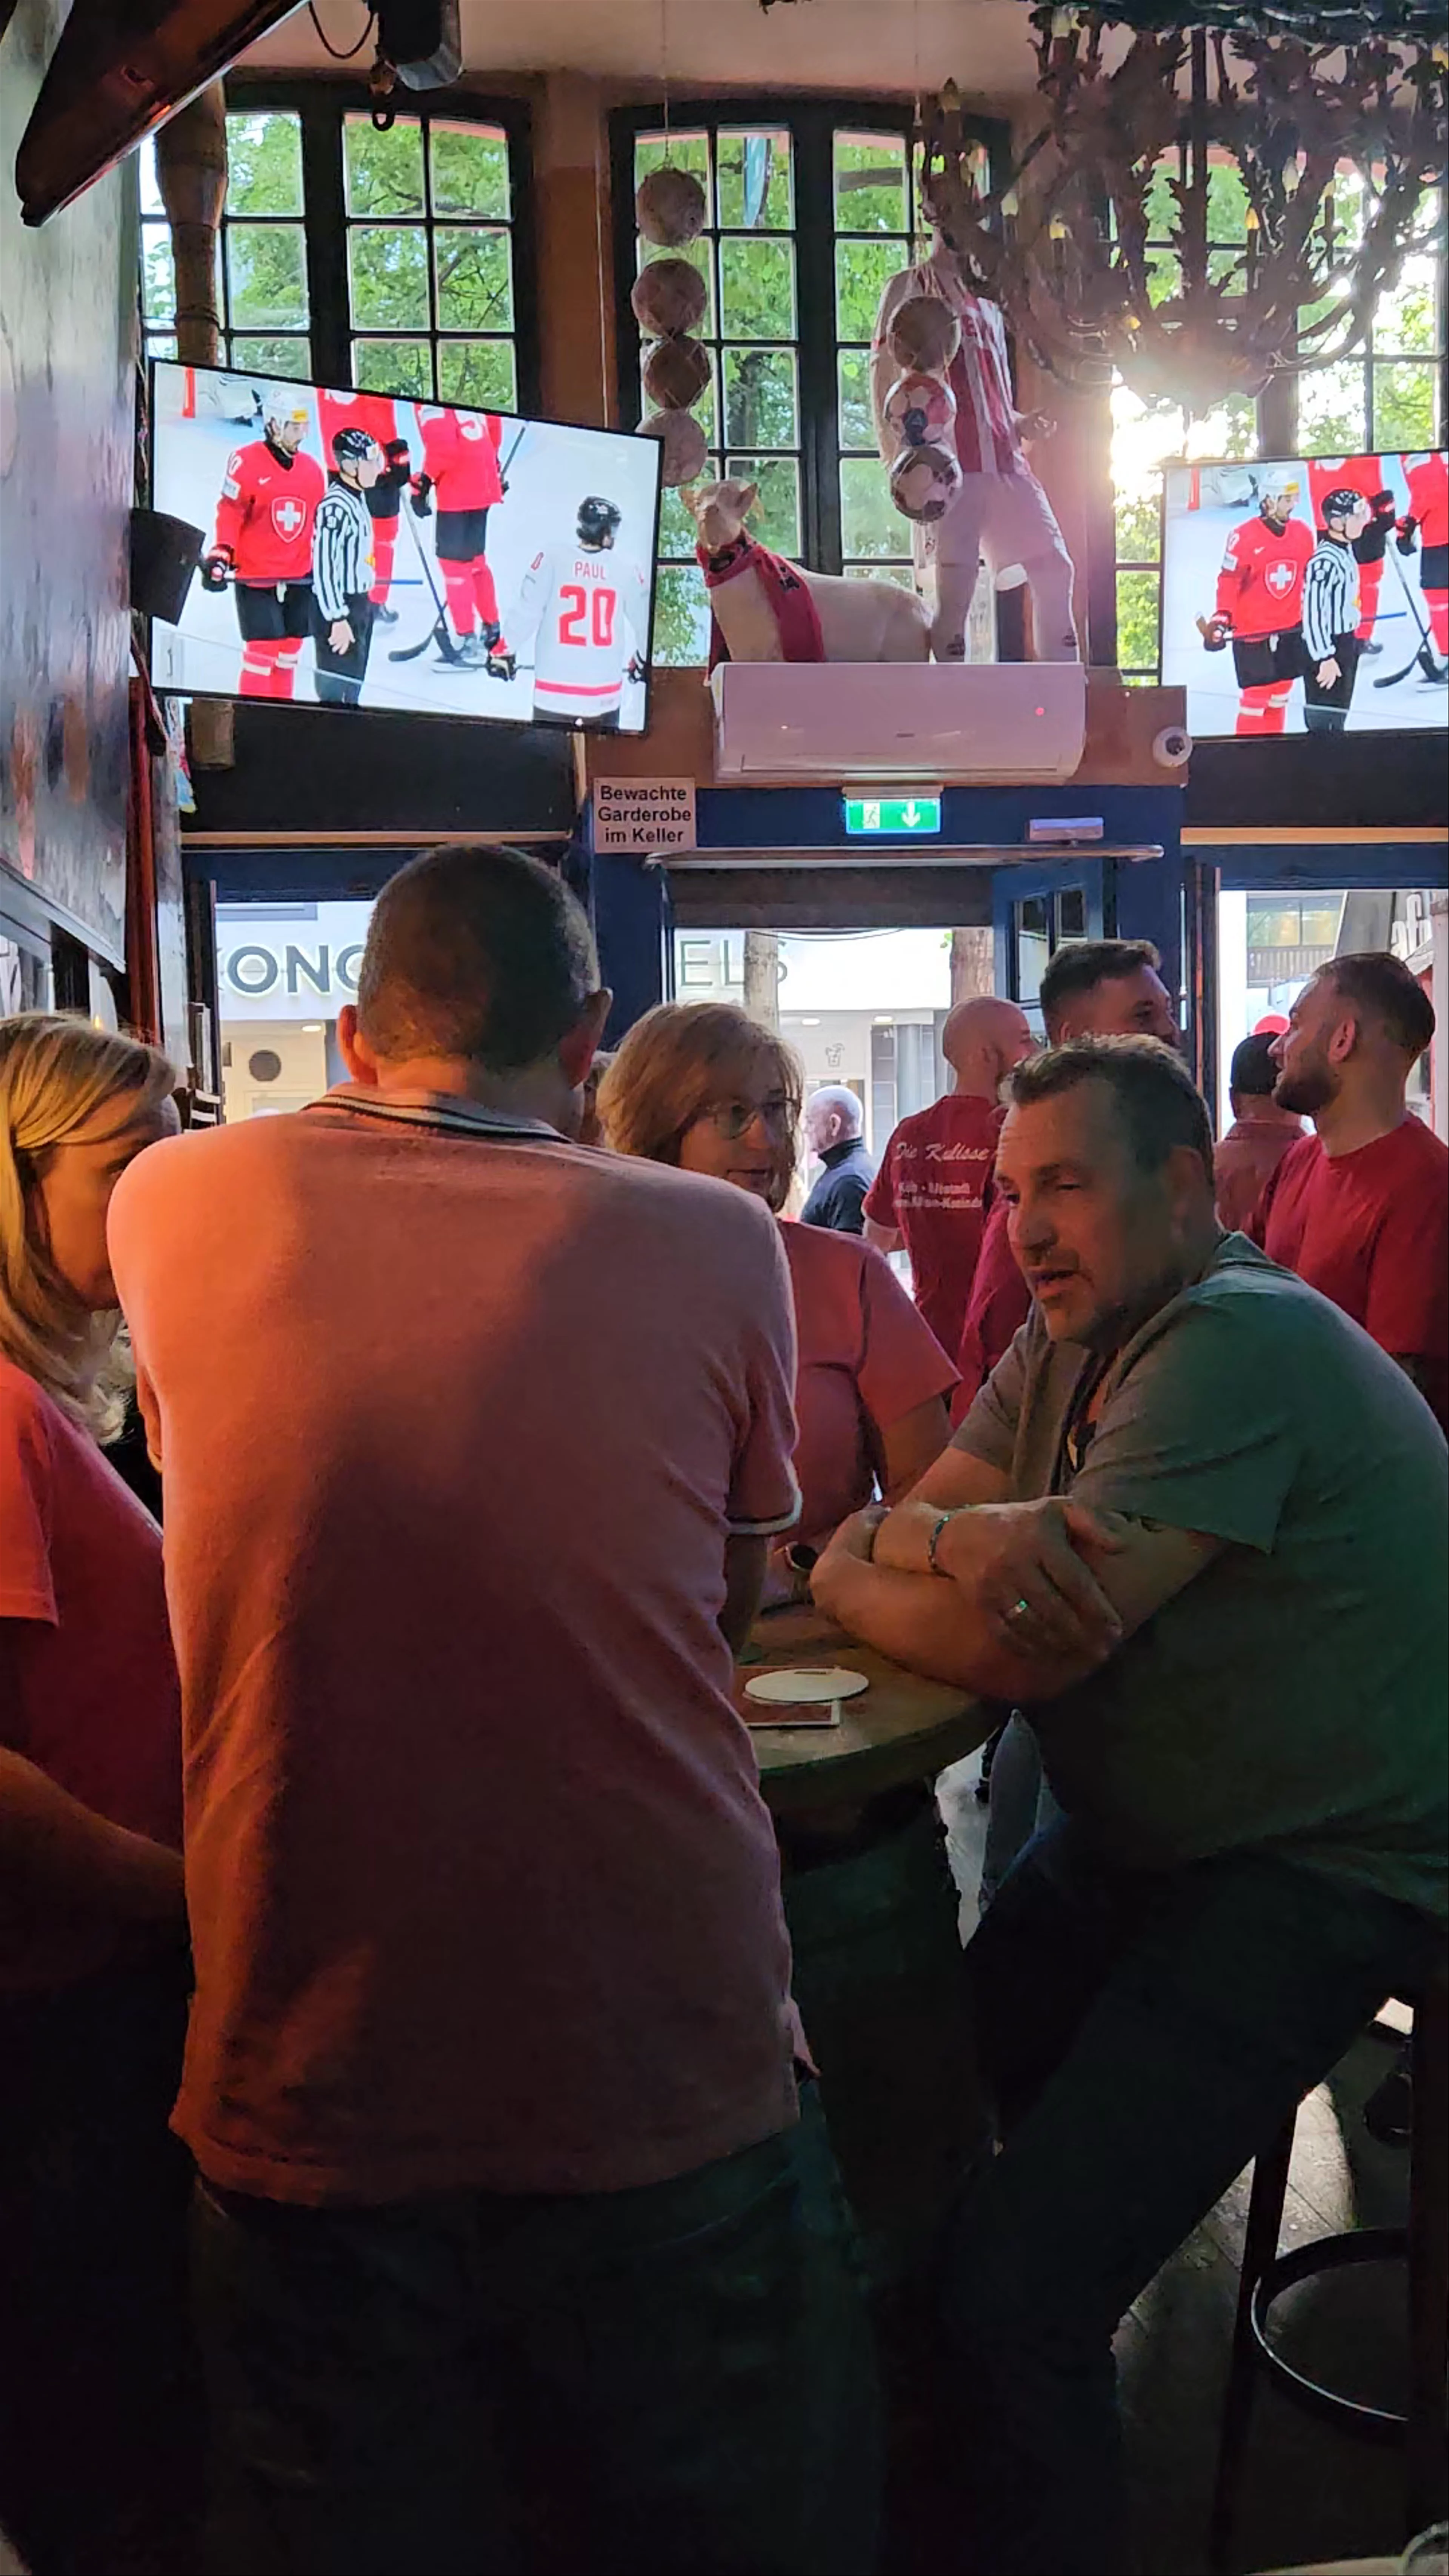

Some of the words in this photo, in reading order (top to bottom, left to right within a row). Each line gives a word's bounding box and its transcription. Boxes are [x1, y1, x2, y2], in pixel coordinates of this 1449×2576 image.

[574, 561, 606, 580] PAUL
[559, 585, 616, 647] 20
[600, 785, 687, 801] Bewachte
[598, 807, 691, 821] Garderobe
[605, 827, 626, 843] im
[632, 827, 684, 843] Keller
